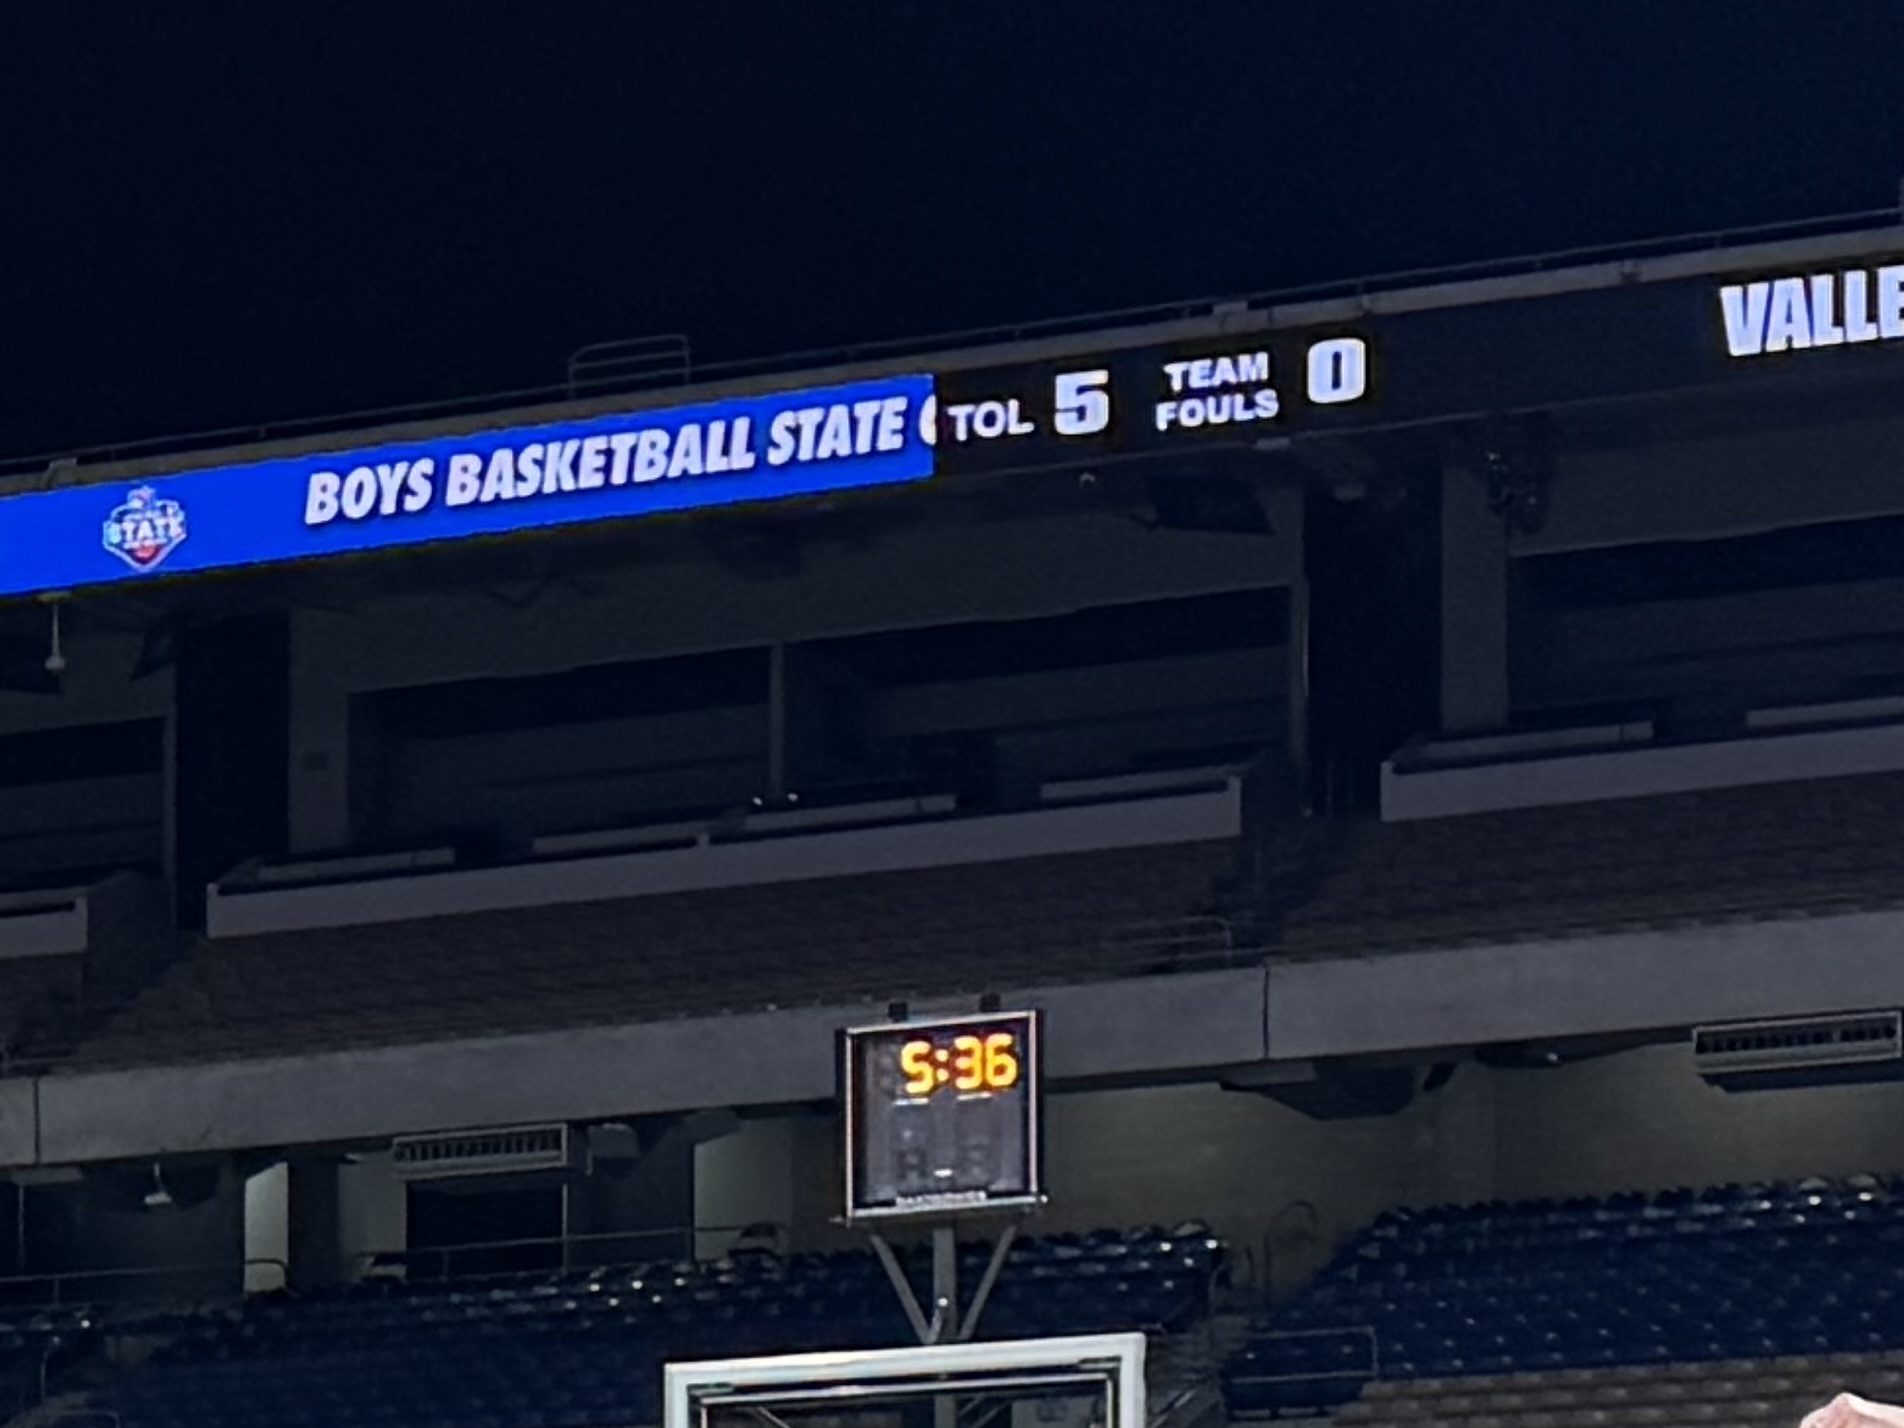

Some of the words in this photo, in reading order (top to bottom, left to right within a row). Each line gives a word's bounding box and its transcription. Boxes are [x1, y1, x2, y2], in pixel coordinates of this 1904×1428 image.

[1720, 264, 1904, 357] VALLE
[1162, 351, 1270, 392] TEAM
[1307, 337, 1366, 403] 0
[947, 398, 1035, 441] TOL
[1053, 369, 1110, 436] 5
[1155, 388, 1280, 431] FOULS
[304, 458, 435, 526] BOYS
[445, 416, 755, 506] BASKETBALL
[767, 396, 909, 469] STATE
[900, 1032, 1019, 1094] 5:36
